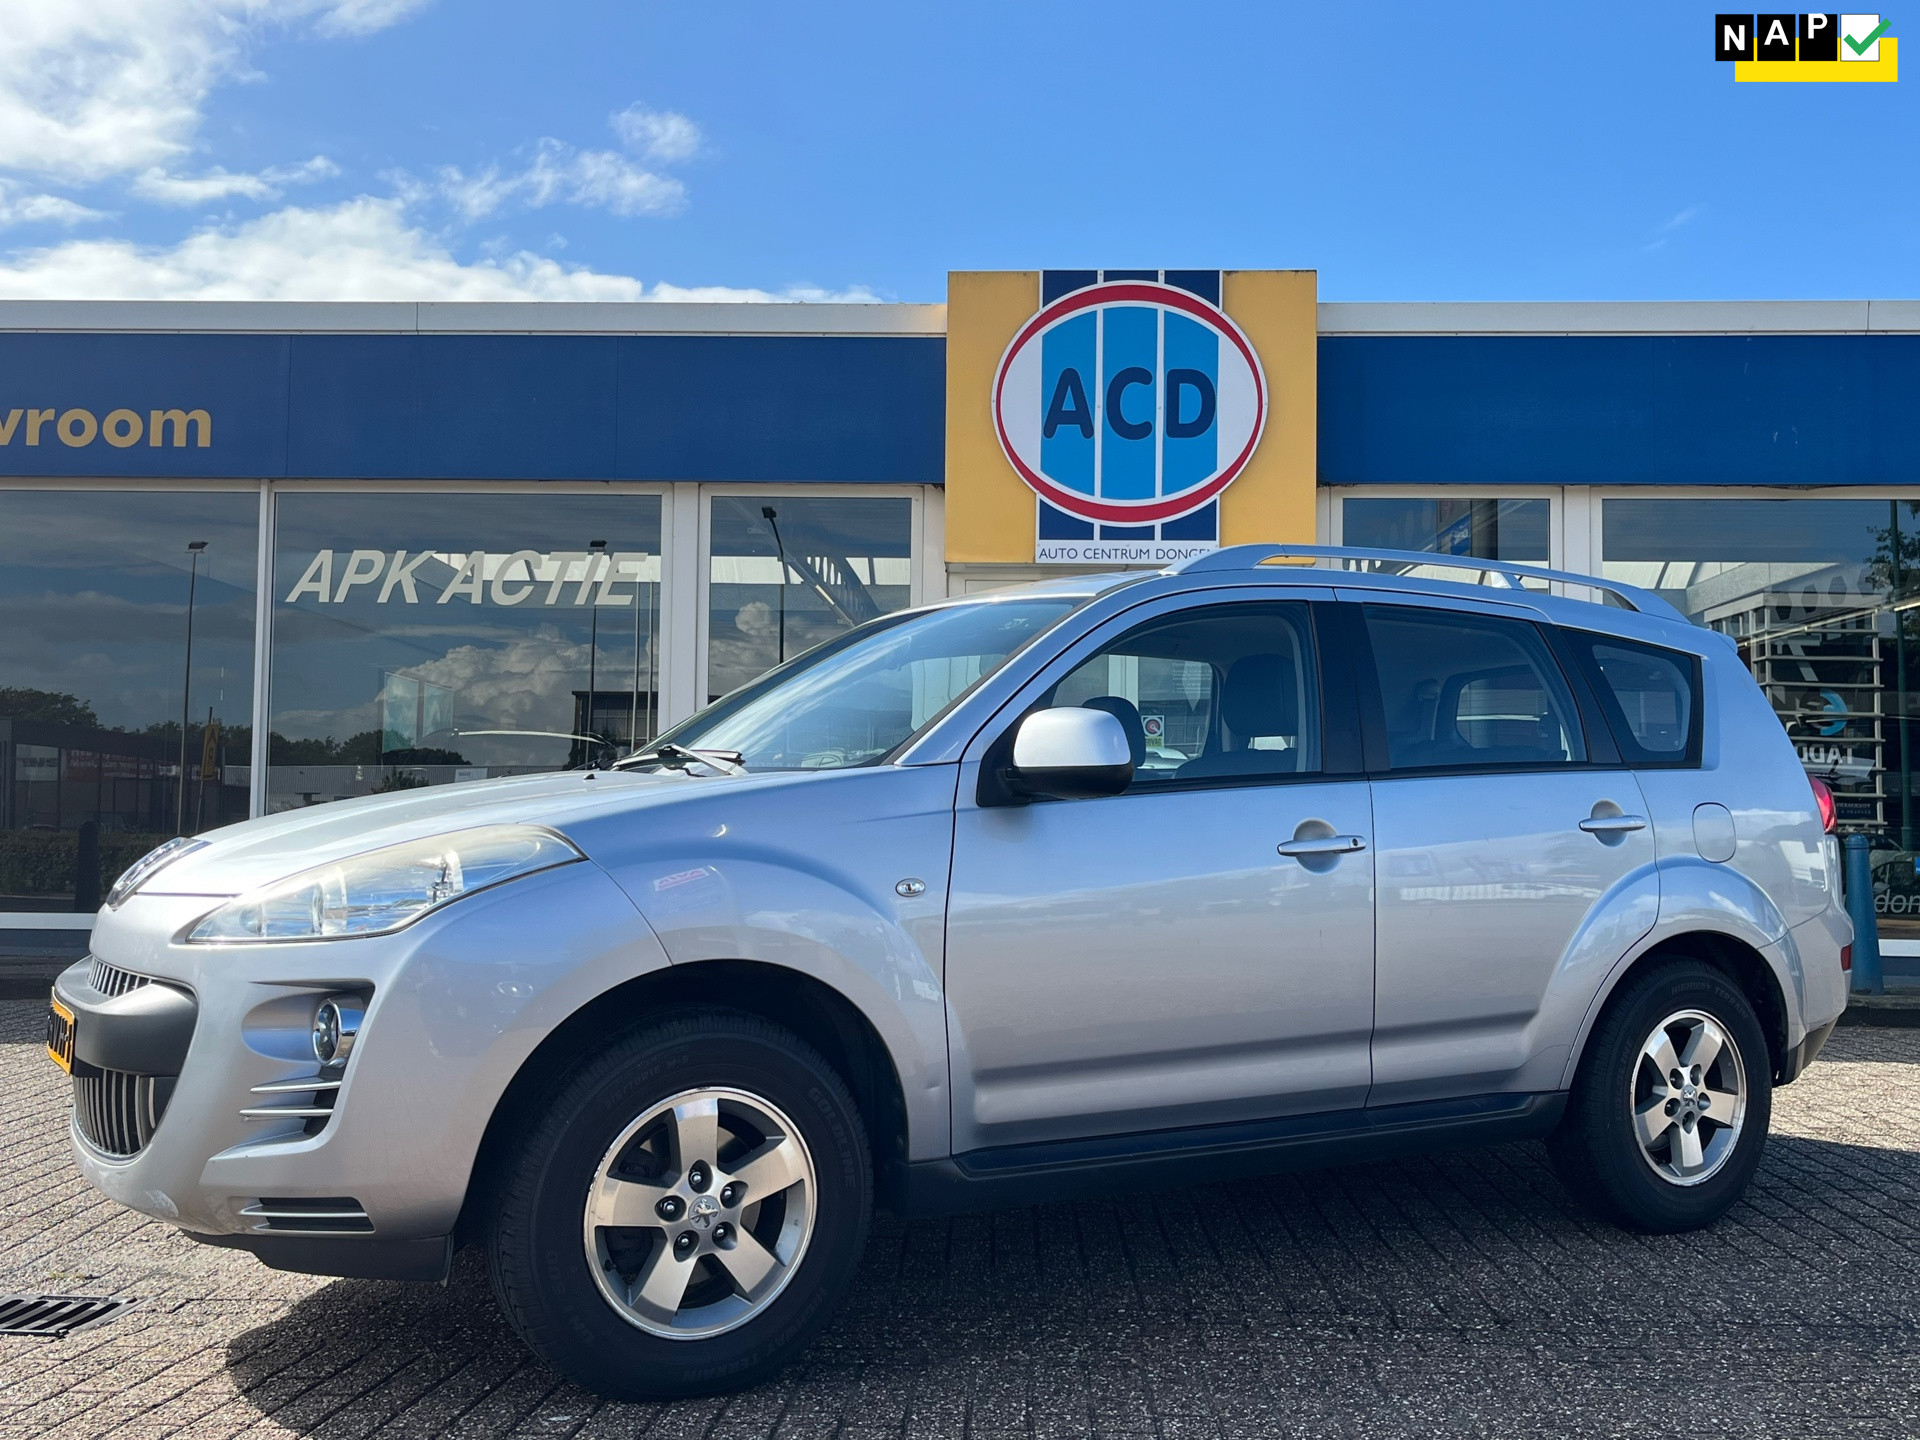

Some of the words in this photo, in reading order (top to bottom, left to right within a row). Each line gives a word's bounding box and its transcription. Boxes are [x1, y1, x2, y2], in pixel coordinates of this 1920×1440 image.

[1043, 366, 1217, 441] ACD
[285, 549, 437, 604] APK
[436, 550, 649, 606] ACTIE
[1038, 547, 1079, 560] AUTO
[1082, 547, 1150, 560] CENTRUM
[1155, 548, 1210, 560] DONG
